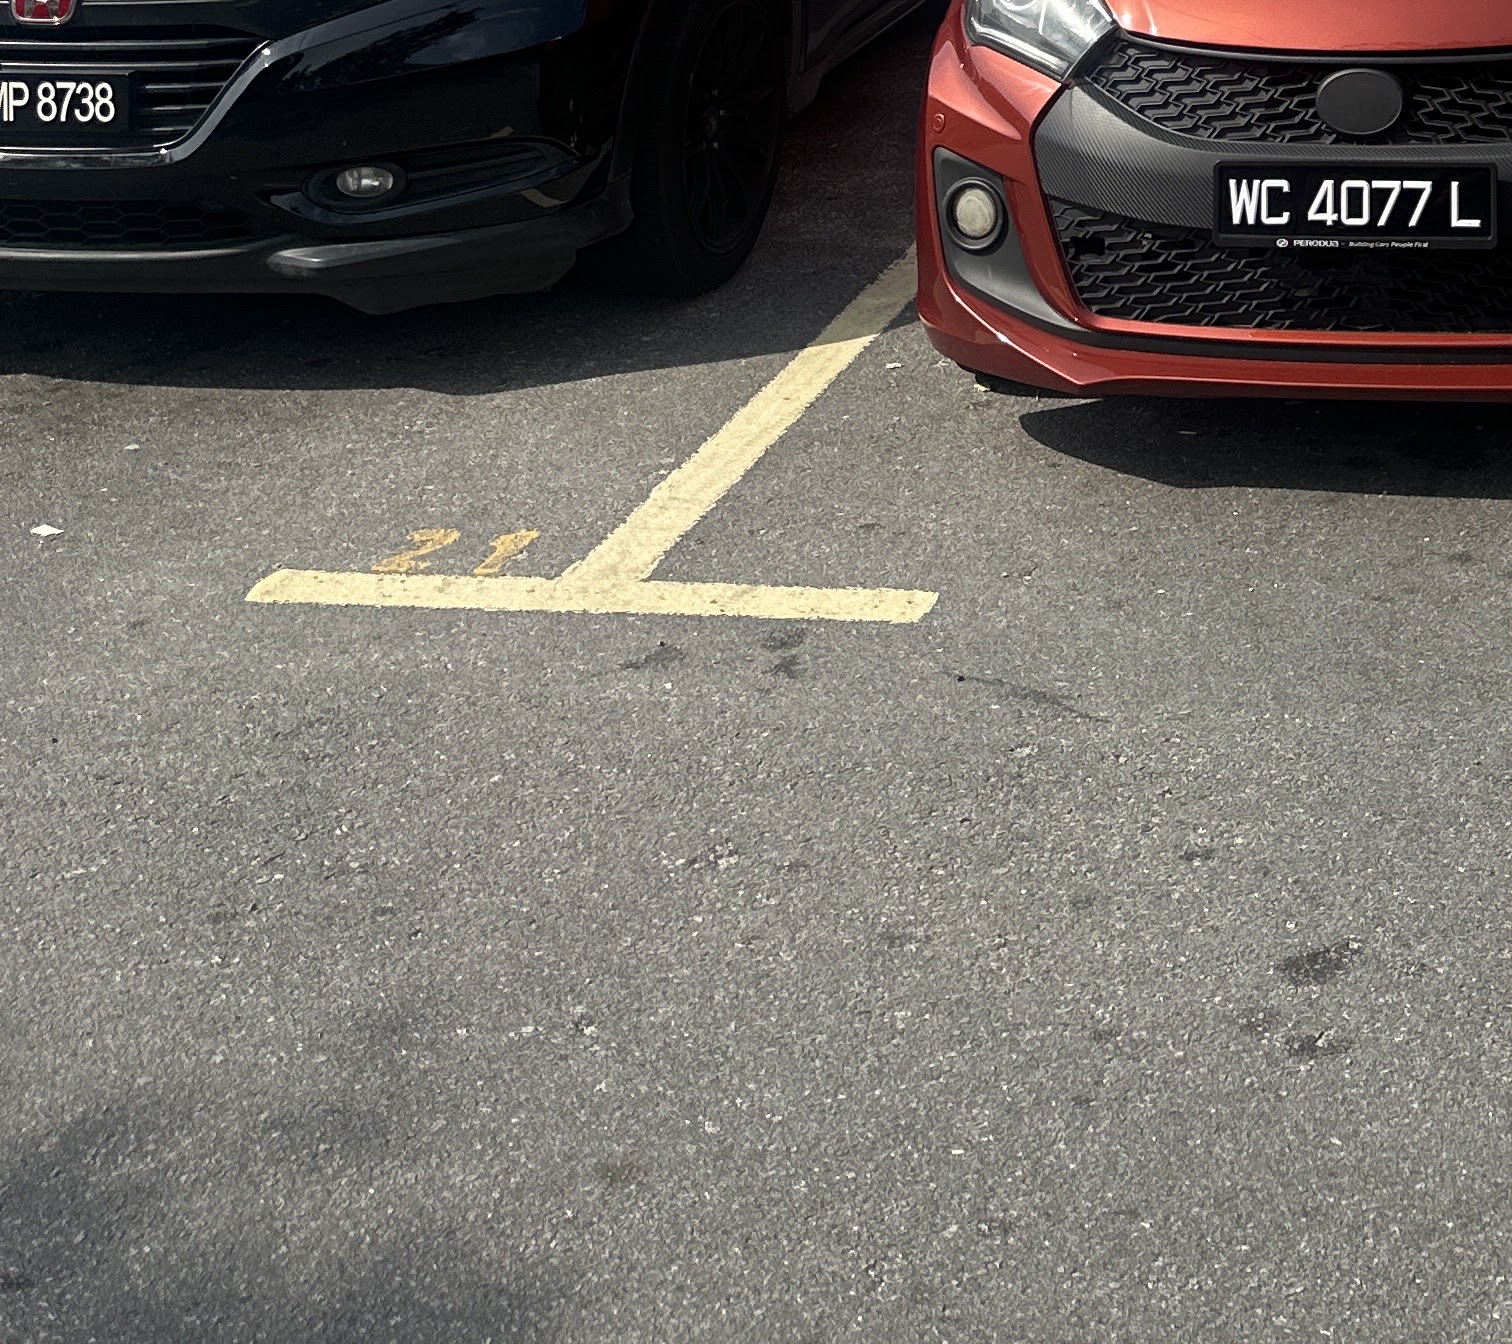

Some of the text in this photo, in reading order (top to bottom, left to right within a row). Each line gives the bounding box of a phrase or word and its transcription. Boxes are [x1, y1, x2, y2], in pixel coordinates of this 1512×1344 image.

[37, 81, 115, 123] 8738
[1228, 178, 1482, 228] WC 4077 L
[1293, 239, 1340, 249] PERODUA
[370, 527, 541, 576] 21
